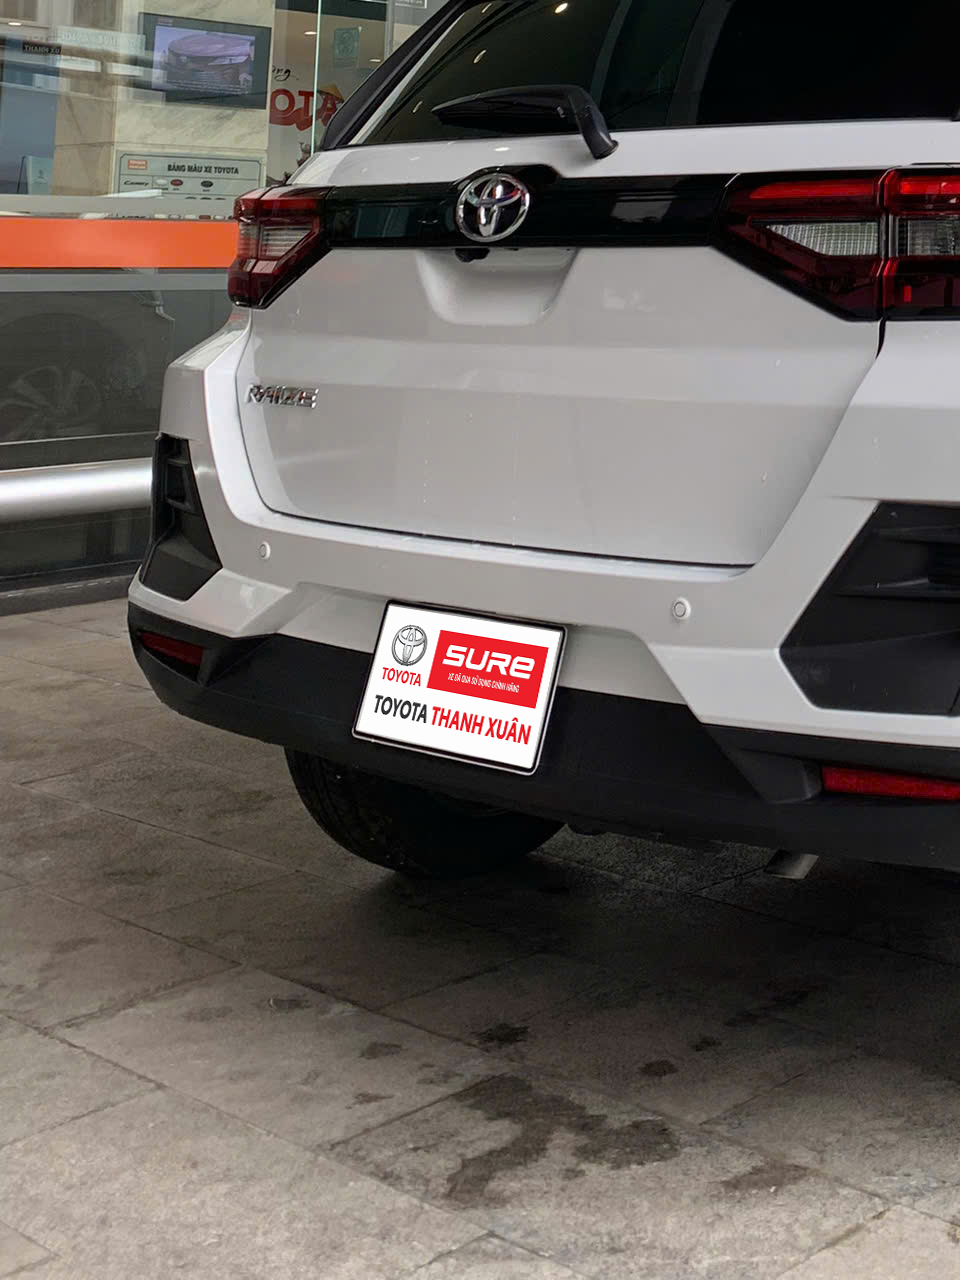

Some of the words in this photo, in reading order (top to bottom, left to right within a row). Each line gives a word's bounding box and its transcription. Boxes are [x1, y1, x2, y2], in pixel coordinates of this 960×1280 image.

[270, 88, 338, 127] OTA
[203, 165, 213, 173] XE
[213, 166, 239, 174] TOYOTA
[245, 384, 319, 409] RAIZE
[382, 667, 422, 687] TOYOTA
[442, 644, 535, 680] SURE
[373, 694, 428, 723] TOYOTA
[431, 706, 485, 735] THANH
[485, 717, 532, 745] XUÂN
